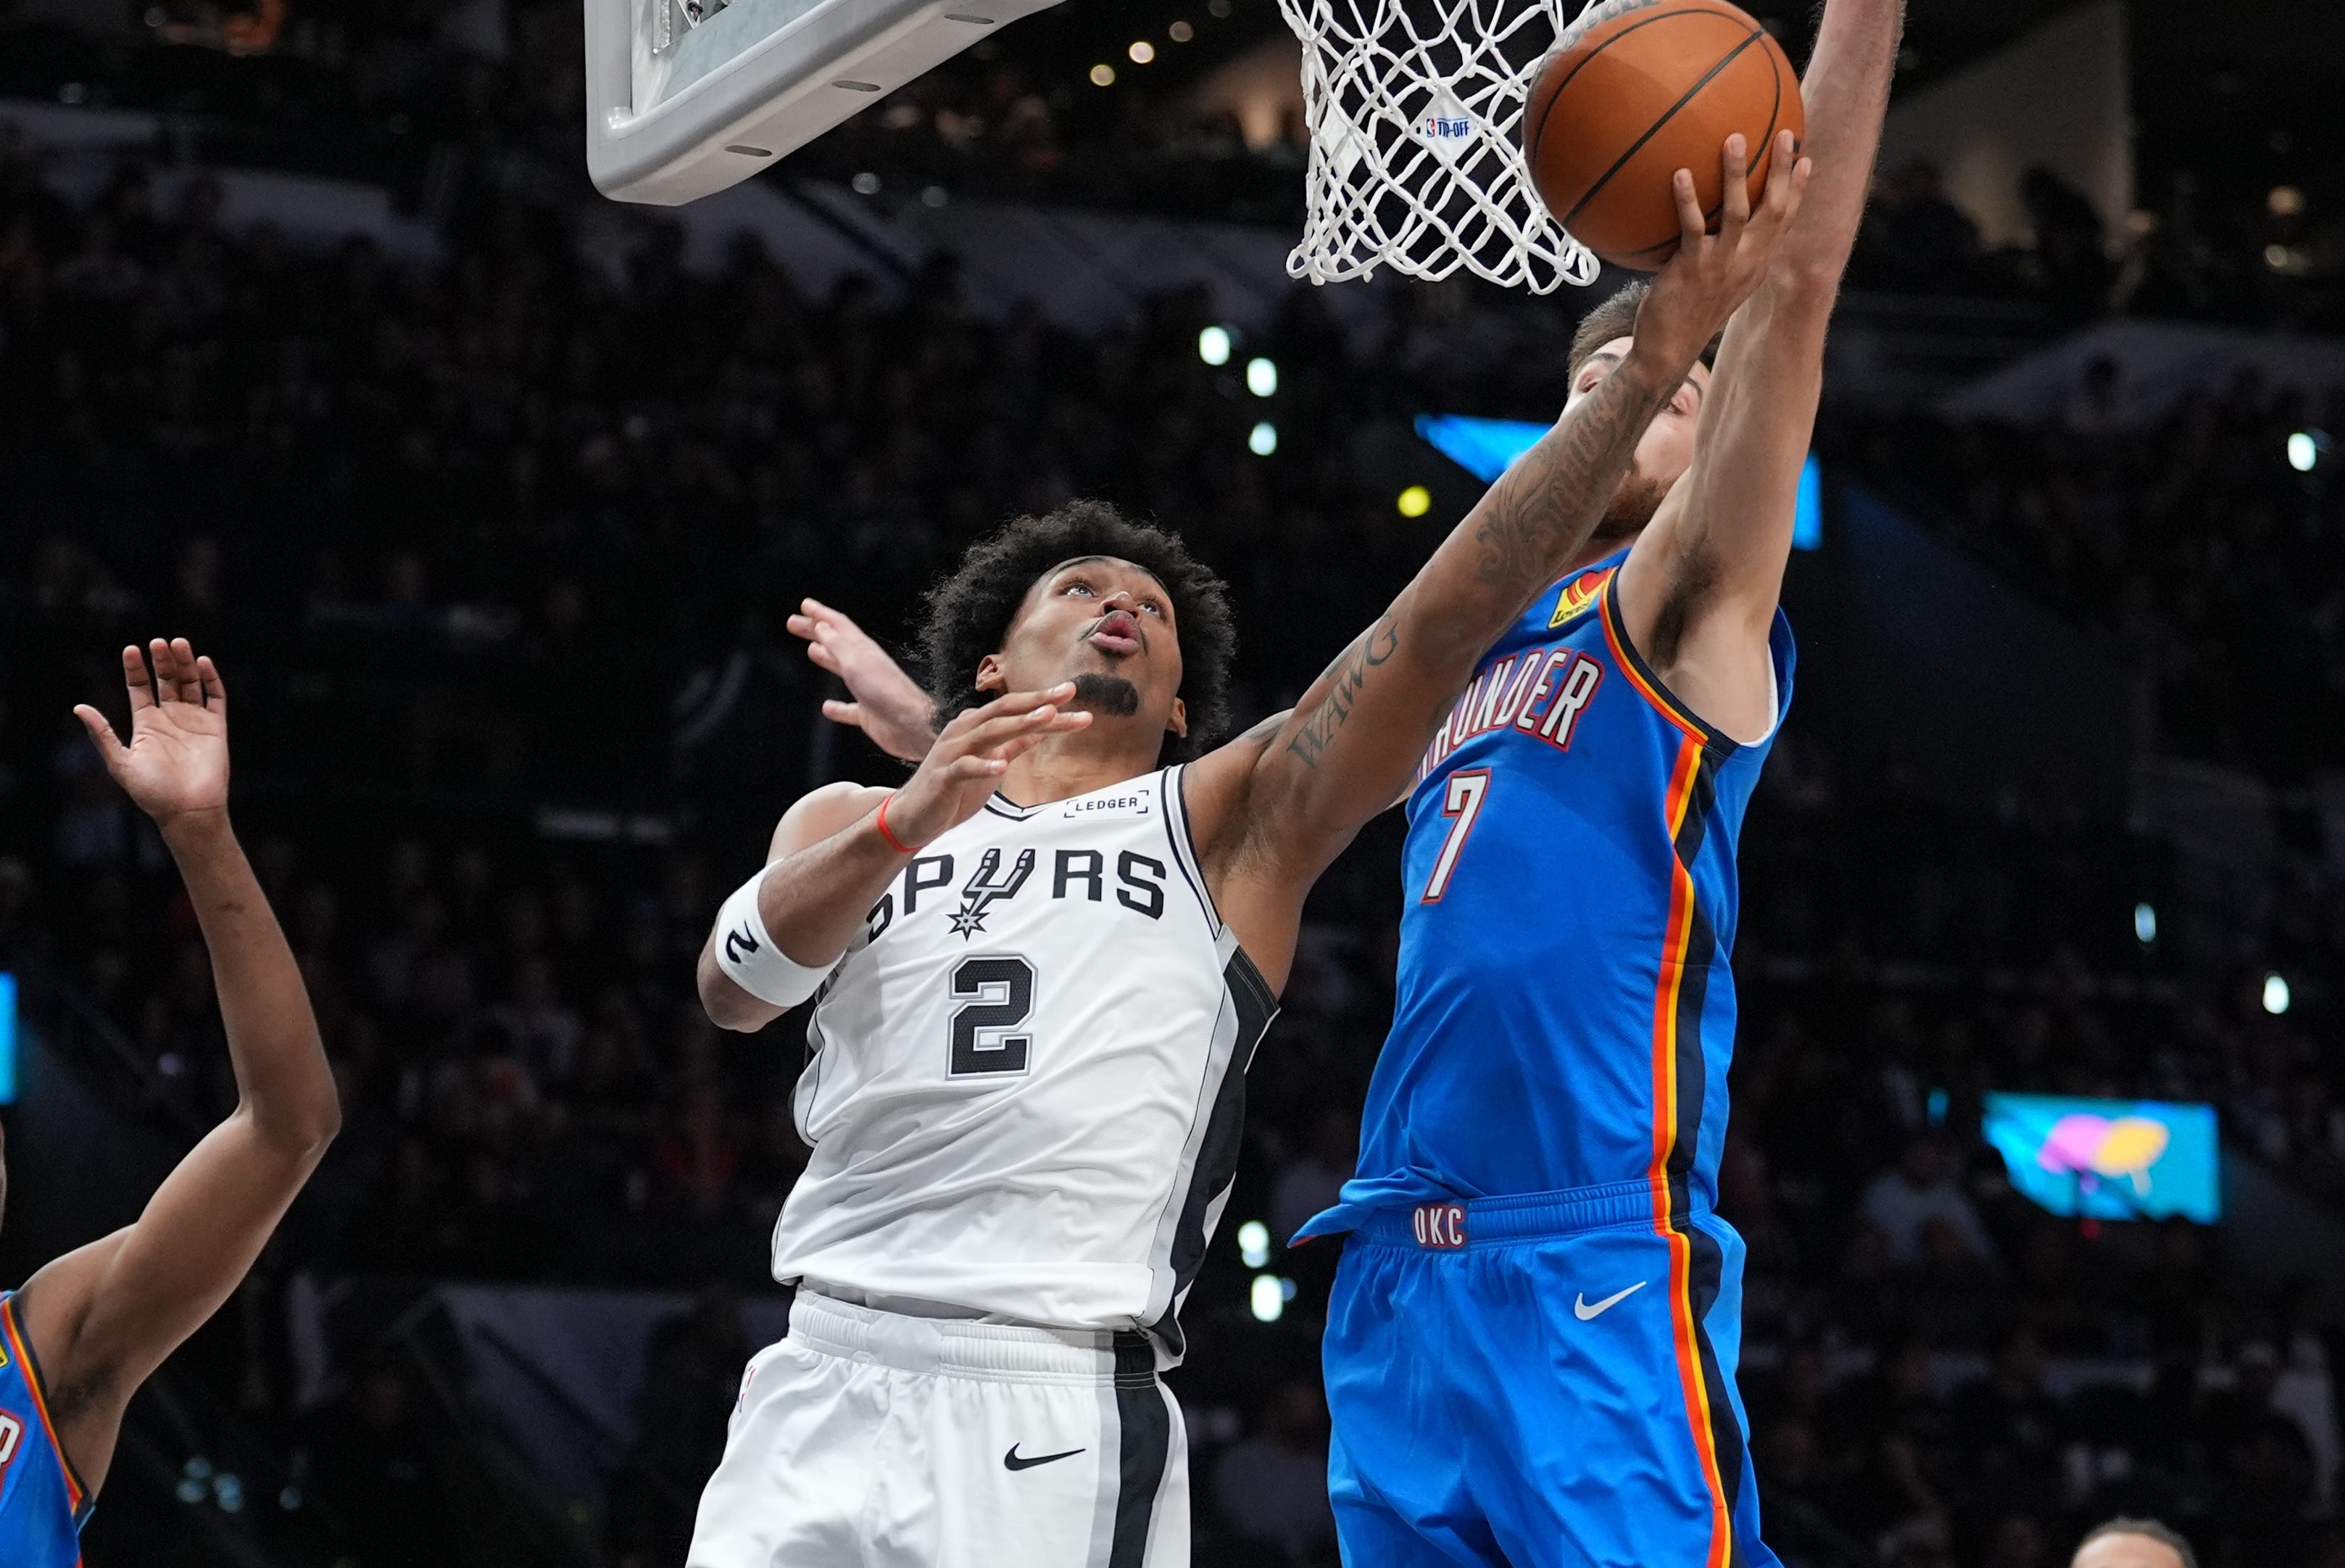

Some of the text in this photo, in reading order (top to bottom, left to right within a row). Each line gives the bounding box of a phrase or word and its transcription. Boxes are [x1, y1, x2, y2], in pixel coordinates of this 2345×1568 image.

[1075, 797, 1138, 812] LEDGER
[1419, 768, 1492, 904] 7
[945, 954, 1038, 1082] 2
[1414, 1206, 1464, 1247] OKC
